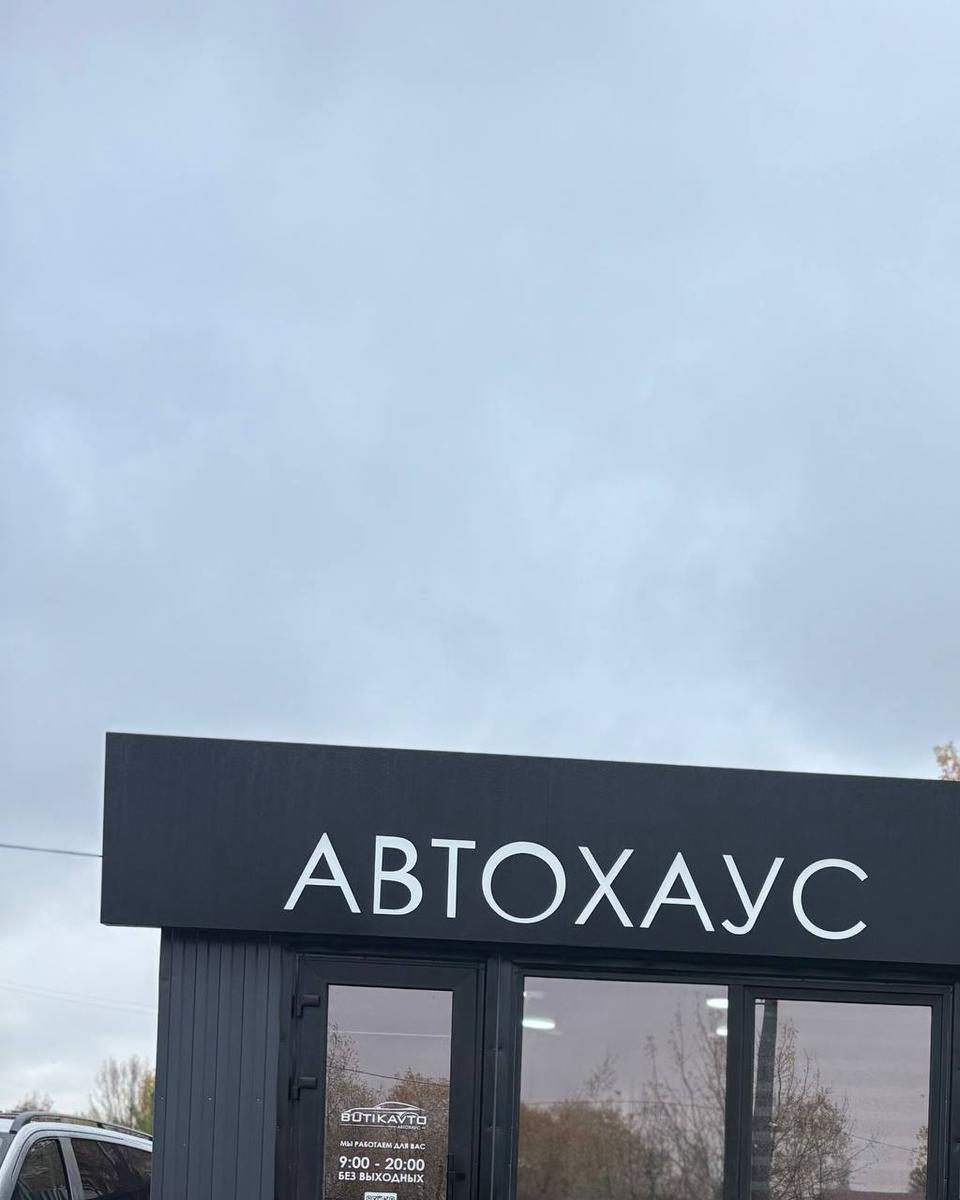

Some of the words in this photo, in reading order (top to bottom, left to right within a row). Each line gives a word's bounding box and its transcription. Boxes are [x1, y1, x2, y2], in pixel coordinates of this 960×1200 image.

[283, 832, 869, 940] АВТОХАУС
[341, 1112, 427, 1125] BUTIKAVTO
[354, 1141, 392, 1149] РАБОТАЕМ
[339, 1155, 370, 1169] 9:00
[384, 1157, 425, 1171] 20:00
[338, 1171, 356, 1181] БЕЗ
[359, 1172, 424, 1183] ВЫХОДНЫХ
